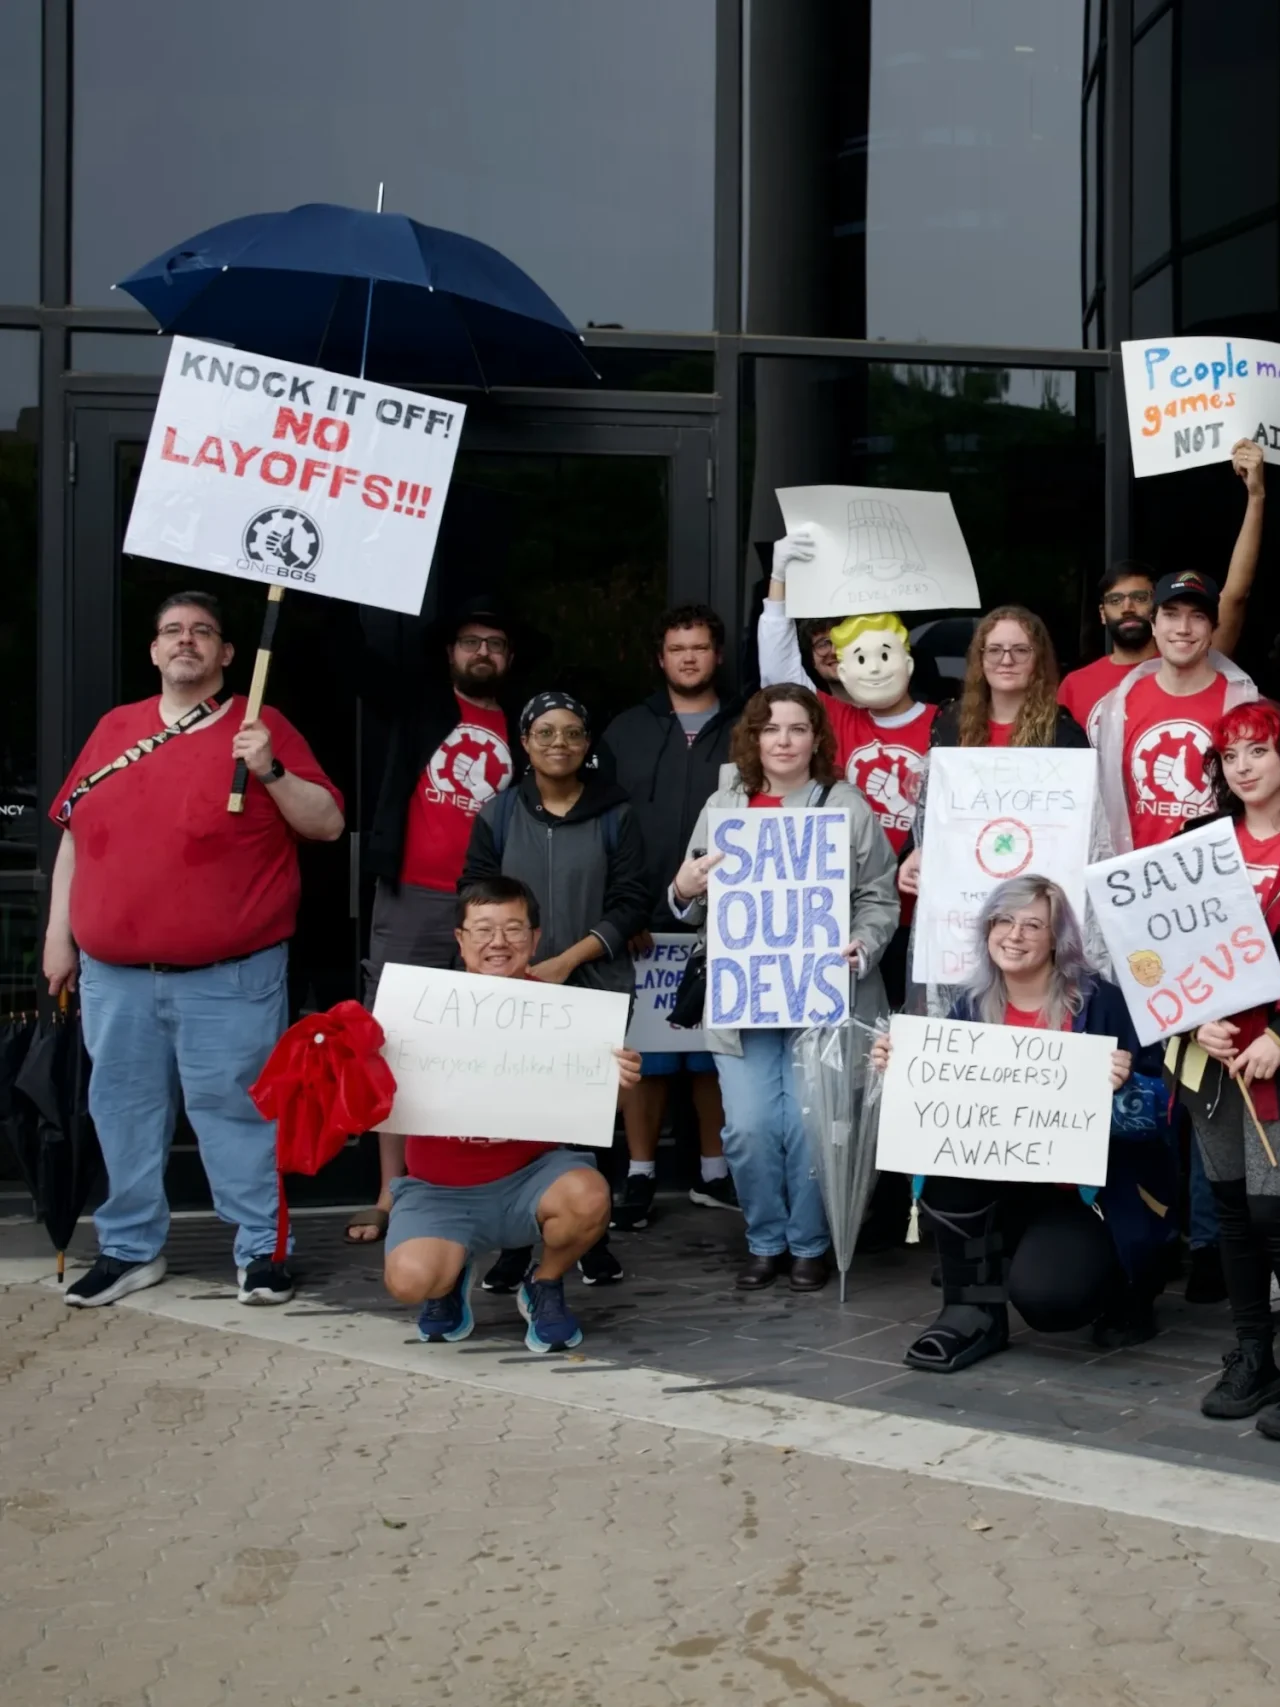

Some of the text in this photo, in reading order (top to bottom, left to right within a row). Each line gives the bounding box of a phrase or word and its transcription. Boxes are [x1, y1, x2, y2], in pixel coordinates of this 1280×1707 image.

[1144, 342, 1249, 390] People
[180, 351, 454, 438] KNOCK IT OFF!
[1141, 392, 1236, 437] games
[272, 406, 350, 452] NO
[1174, 422, 1224, 458] NOT
[160, 426, 432, 518] LAYOFFS!!!
[236, 557, 316, 583] ONEBGS
[951, 788, 1077, 812] LAYOFFS
[714, 814, 846, 886] SAVE
[1106, 836, 1240, 907] SAVE
[717, 886, 840, 950] OUR
[1147, 897, 1228, 941] OUR
[711, 952, 848, 1025] DEVS
[1146, 925, 1266, 1032] DEVS
[413, 985, 575, 1030] LAYOFFS
[923, 1024, 1064, 1062] HEY YOU
[907, 1056, 1068, 1091] (DEVELOPERS!)
[914, 1101, 1097, 1132] YOU'RE FINALLY
[933, 1136, 1054, 1167] AWAKE!
